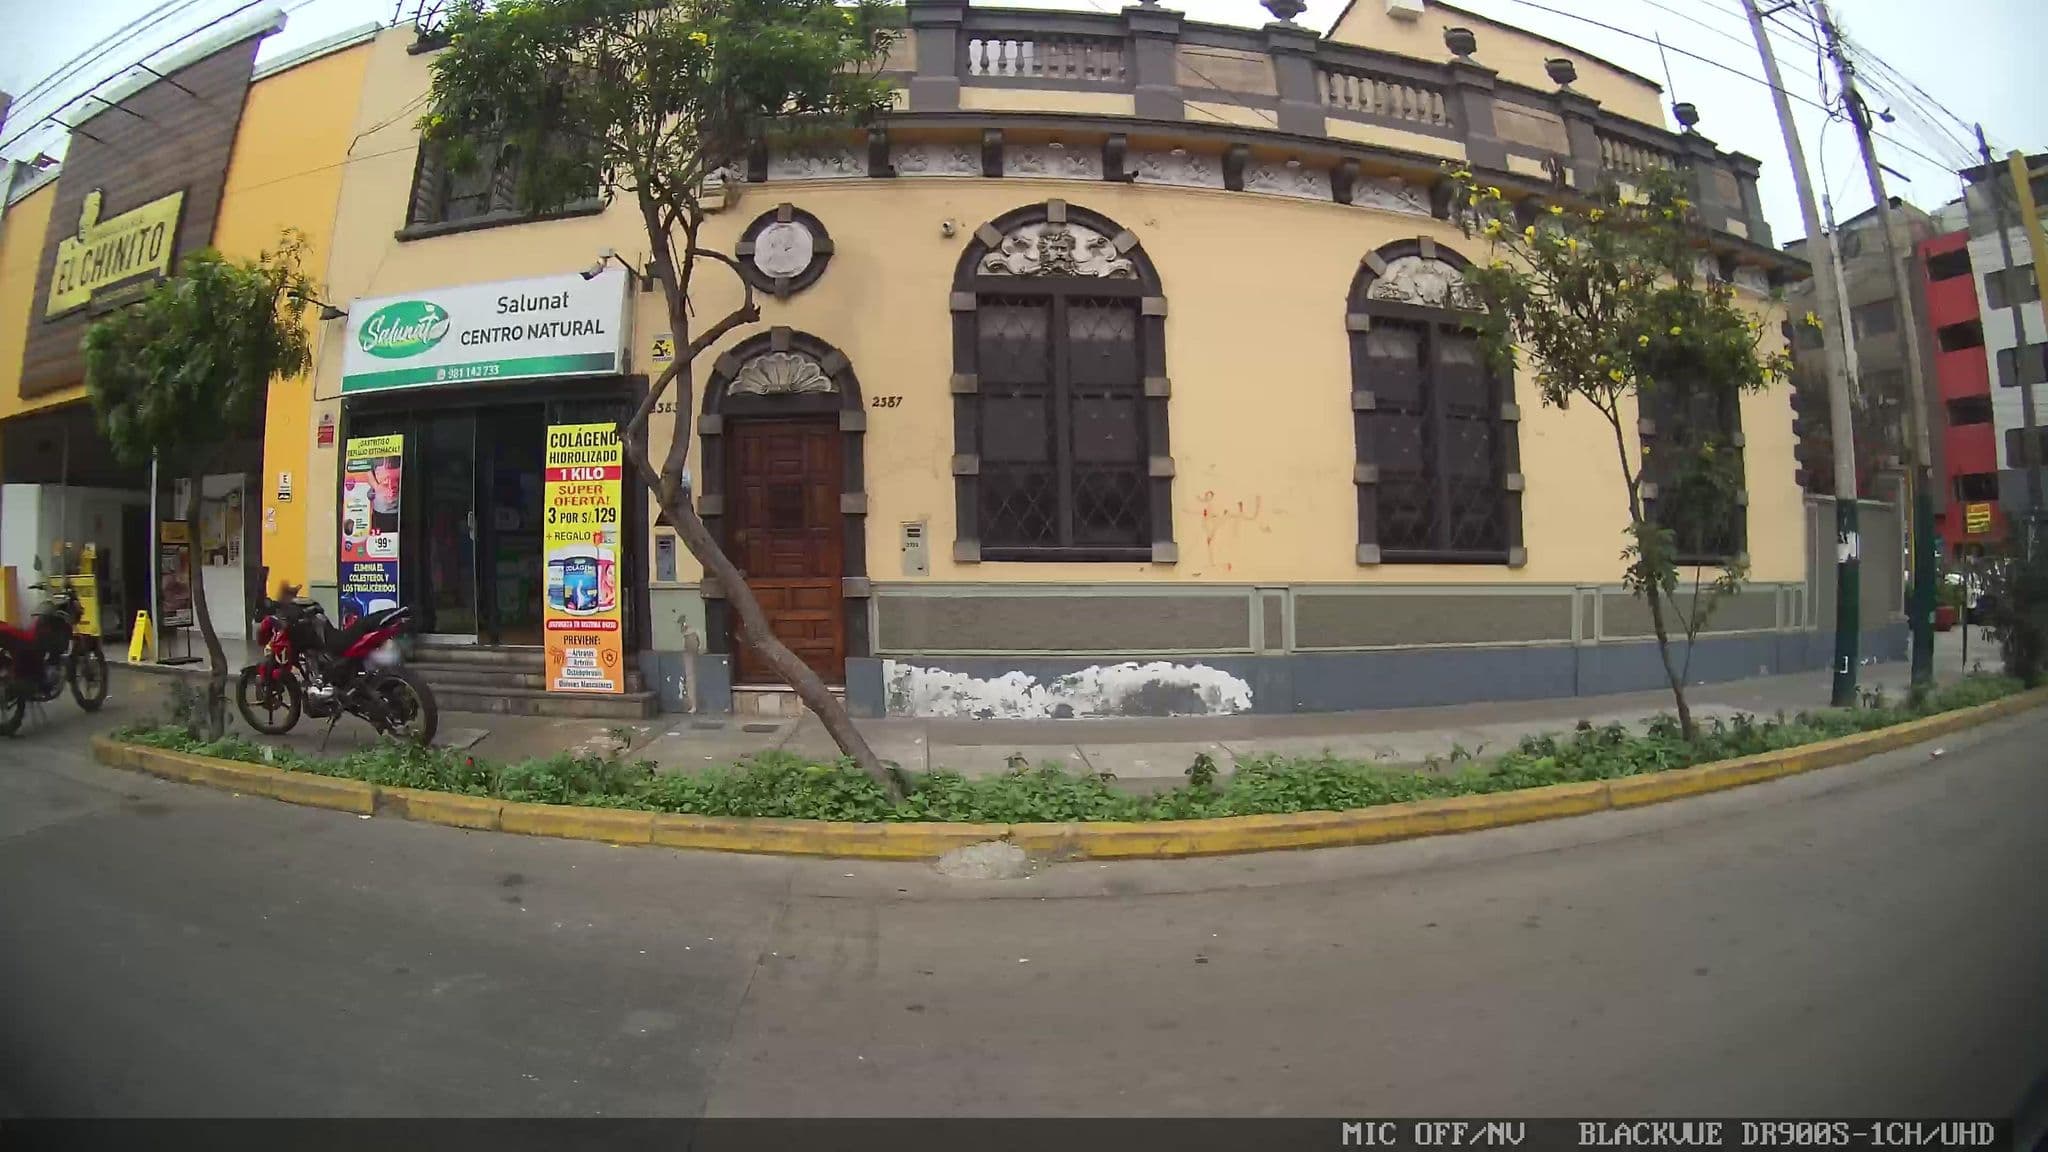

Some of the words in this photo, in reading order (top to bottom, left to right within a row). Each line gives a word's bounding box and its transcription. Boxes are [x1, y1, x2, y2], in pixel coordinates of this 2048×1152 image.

[80, 221, 165, 286] CHINITO
[497, 291, 569, 314] Salunat
[363, 312, 439, 352] Salunat
[460, 326, 523, 346] CENTRO
[527, 319, 605, 341] NATURAL
[550, 428, 618, 448] COLÁGENO
[549, 450, 617, 464] HIDROLIZADO
[560, 468, 567, 480] 1
[571, 467, 604, 481] KILO
[554, 496, 610, 506] OFERTA!
[548, 508, 556, 524] 3
[560, 512, 578, 524] POR
[555, 531, 591, 541] REGALO
[563, 635, 601, 645] PREVIENE:
